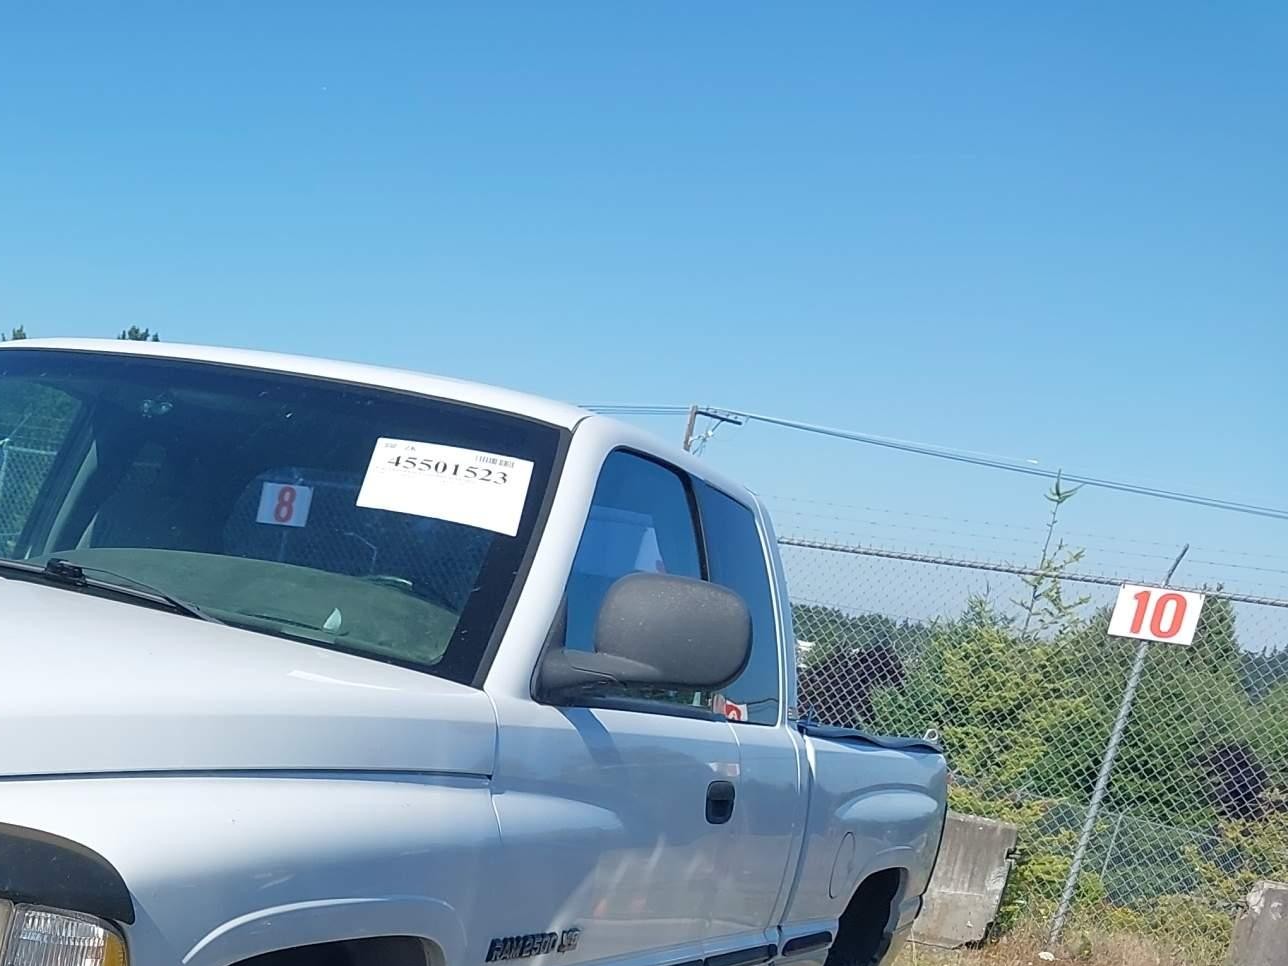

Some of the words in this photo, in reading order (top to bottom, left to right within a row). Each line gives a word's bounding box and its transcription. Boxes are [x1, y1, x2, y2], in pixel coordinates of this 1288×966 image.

[387, 455, 509, 485] 45501523
[273, 485, 297, 522] 8
[1129, 590, 1187, 639] 10
